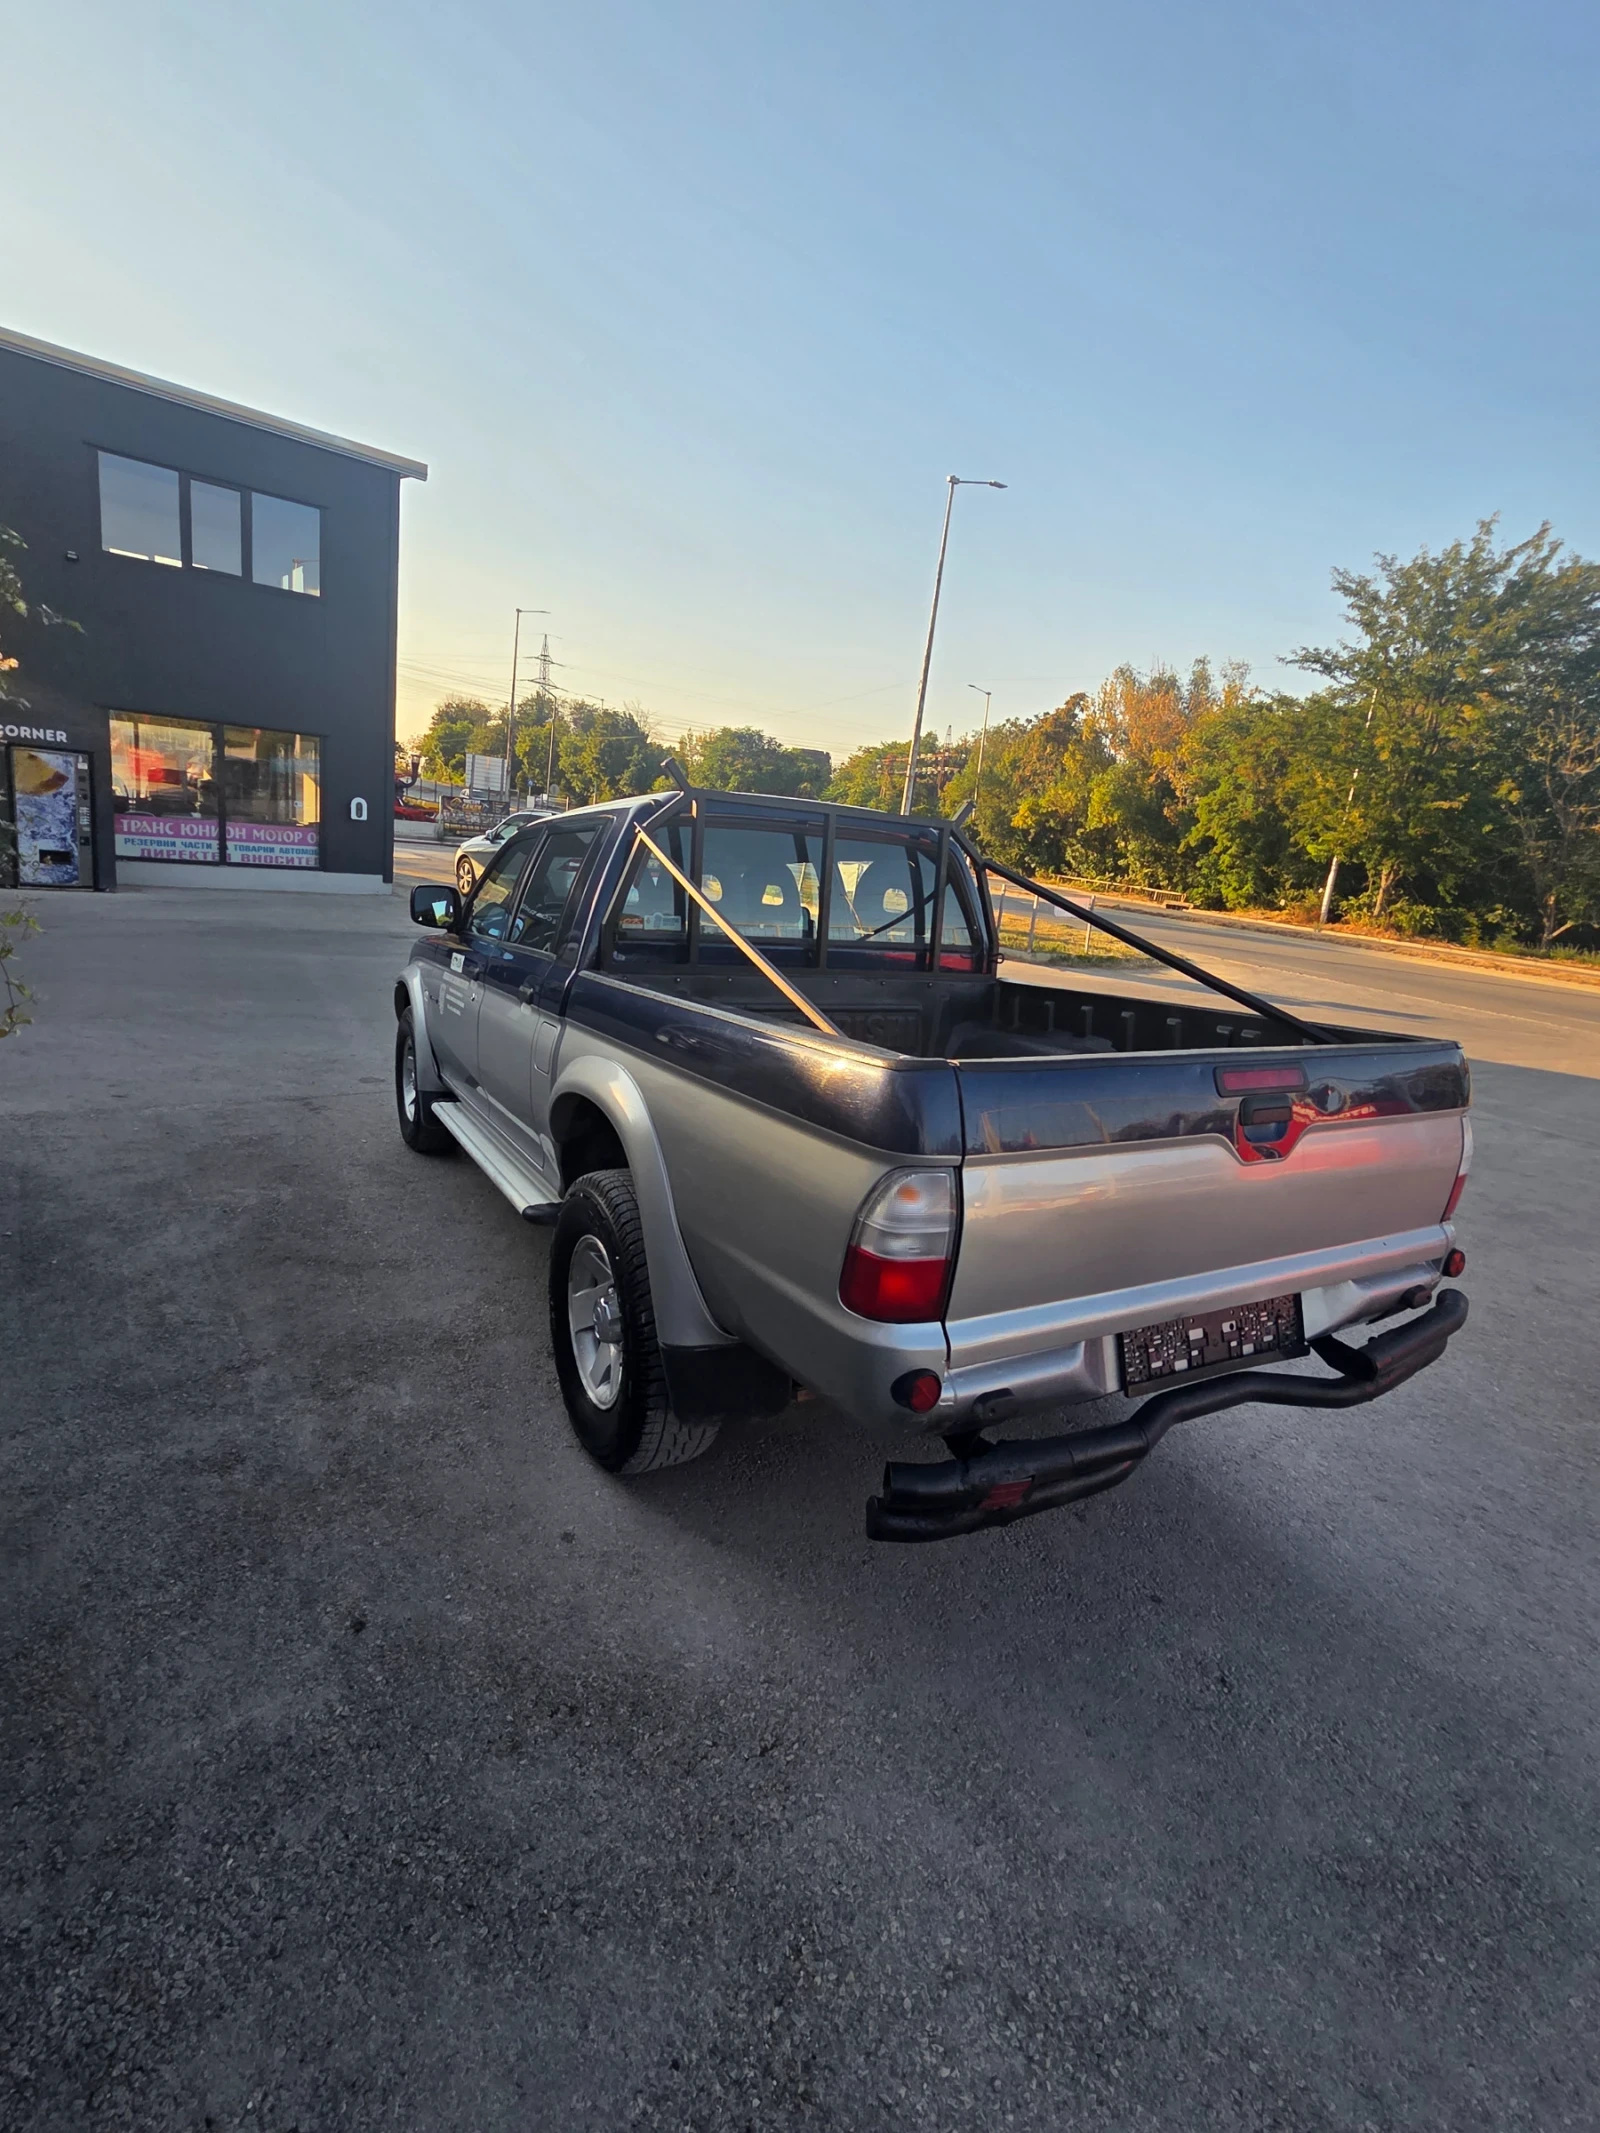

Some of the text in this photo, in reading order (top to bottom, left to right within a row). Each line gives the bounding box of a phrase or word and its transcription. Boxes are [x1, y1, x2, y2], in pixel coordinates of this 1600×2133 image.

[0, 724, 68, 743] ORNER
[120, 819, 175, 835] ТРАНС
[180, 823, 246, 839] ЮНИОН
[253, 828, 303, 843] МОТОР
[124, 837, 176, 848] РЕЗЕРВНИ
[180, 841, 213, 850] ЧАСТИ
[234, 844, 275, 854] ТОВАРНИ
